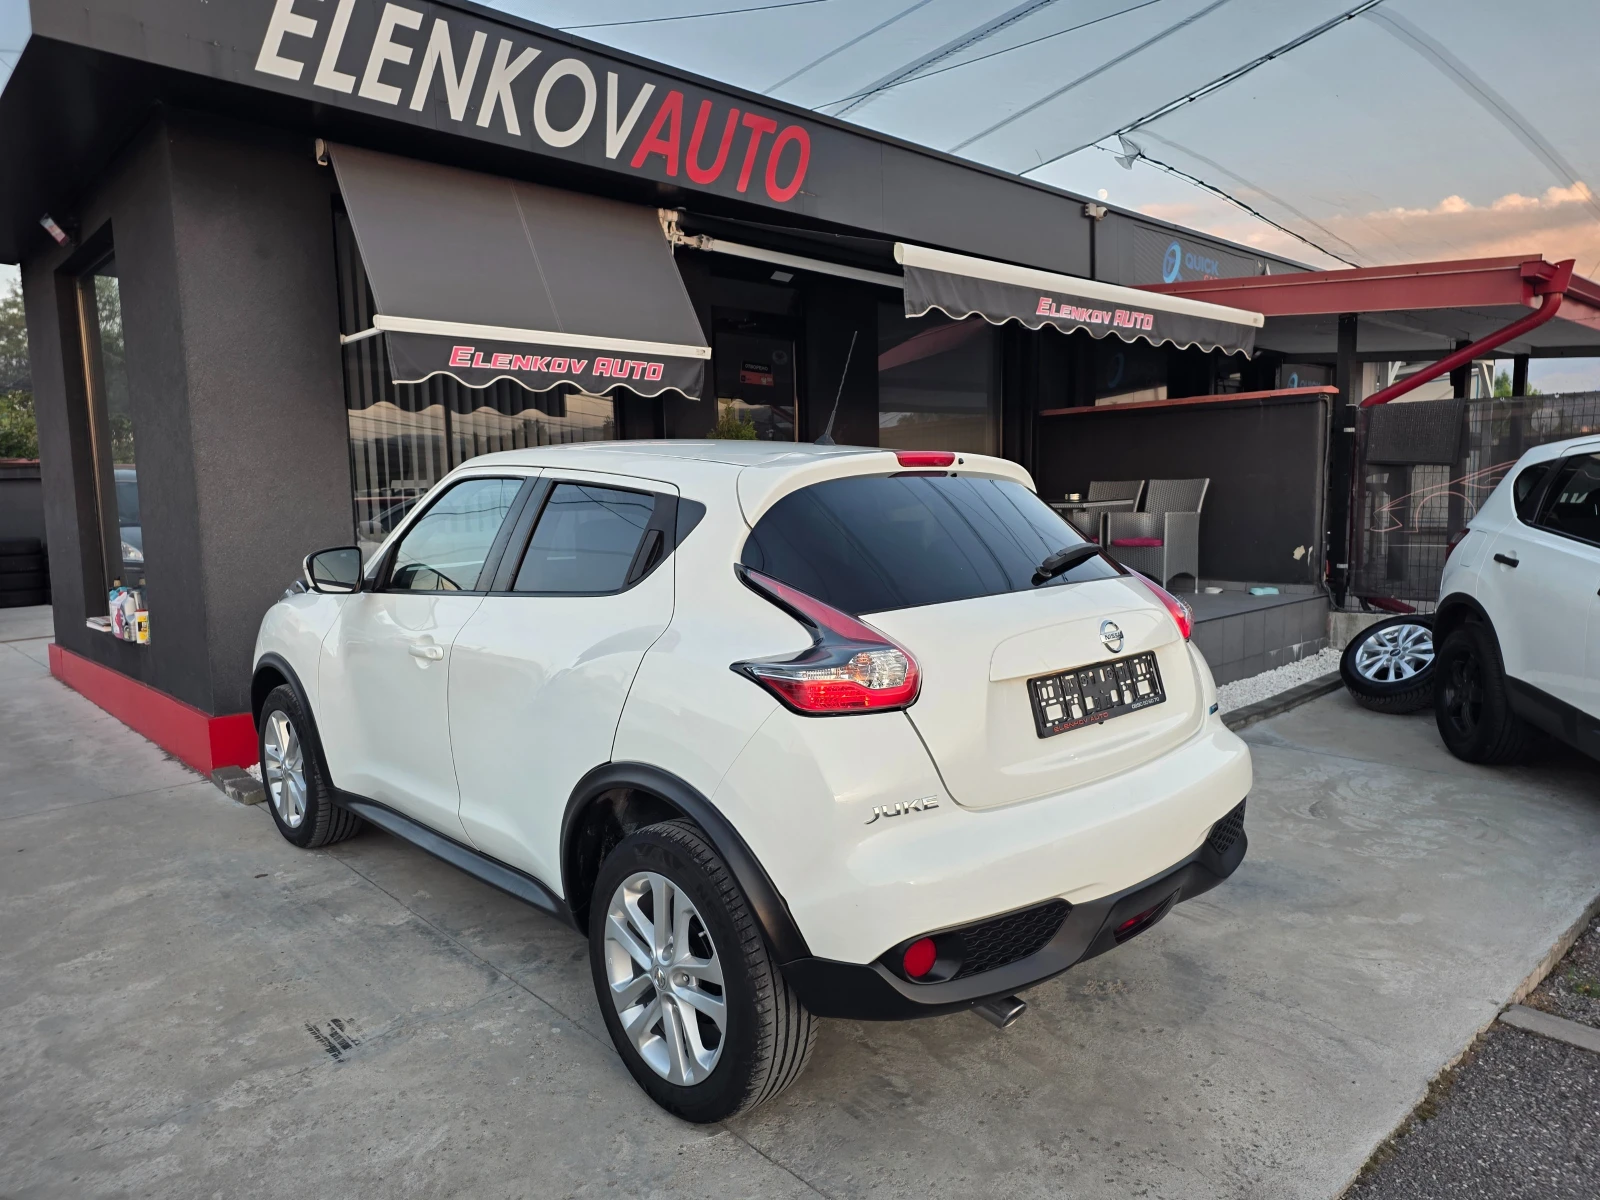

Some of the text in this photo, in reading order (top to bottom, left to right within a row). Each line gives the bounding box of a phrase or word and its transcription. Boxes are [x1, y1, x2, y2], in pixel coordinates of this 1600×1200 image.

[1185, 253, 1220, 276] QUICK
[1113, 309, 1154, 331] AUTO
[592, 356, 664, 381] AUTO
[1090, 711, 1109, 721] AUTO
[864, 795, 939, 825] JUKE
